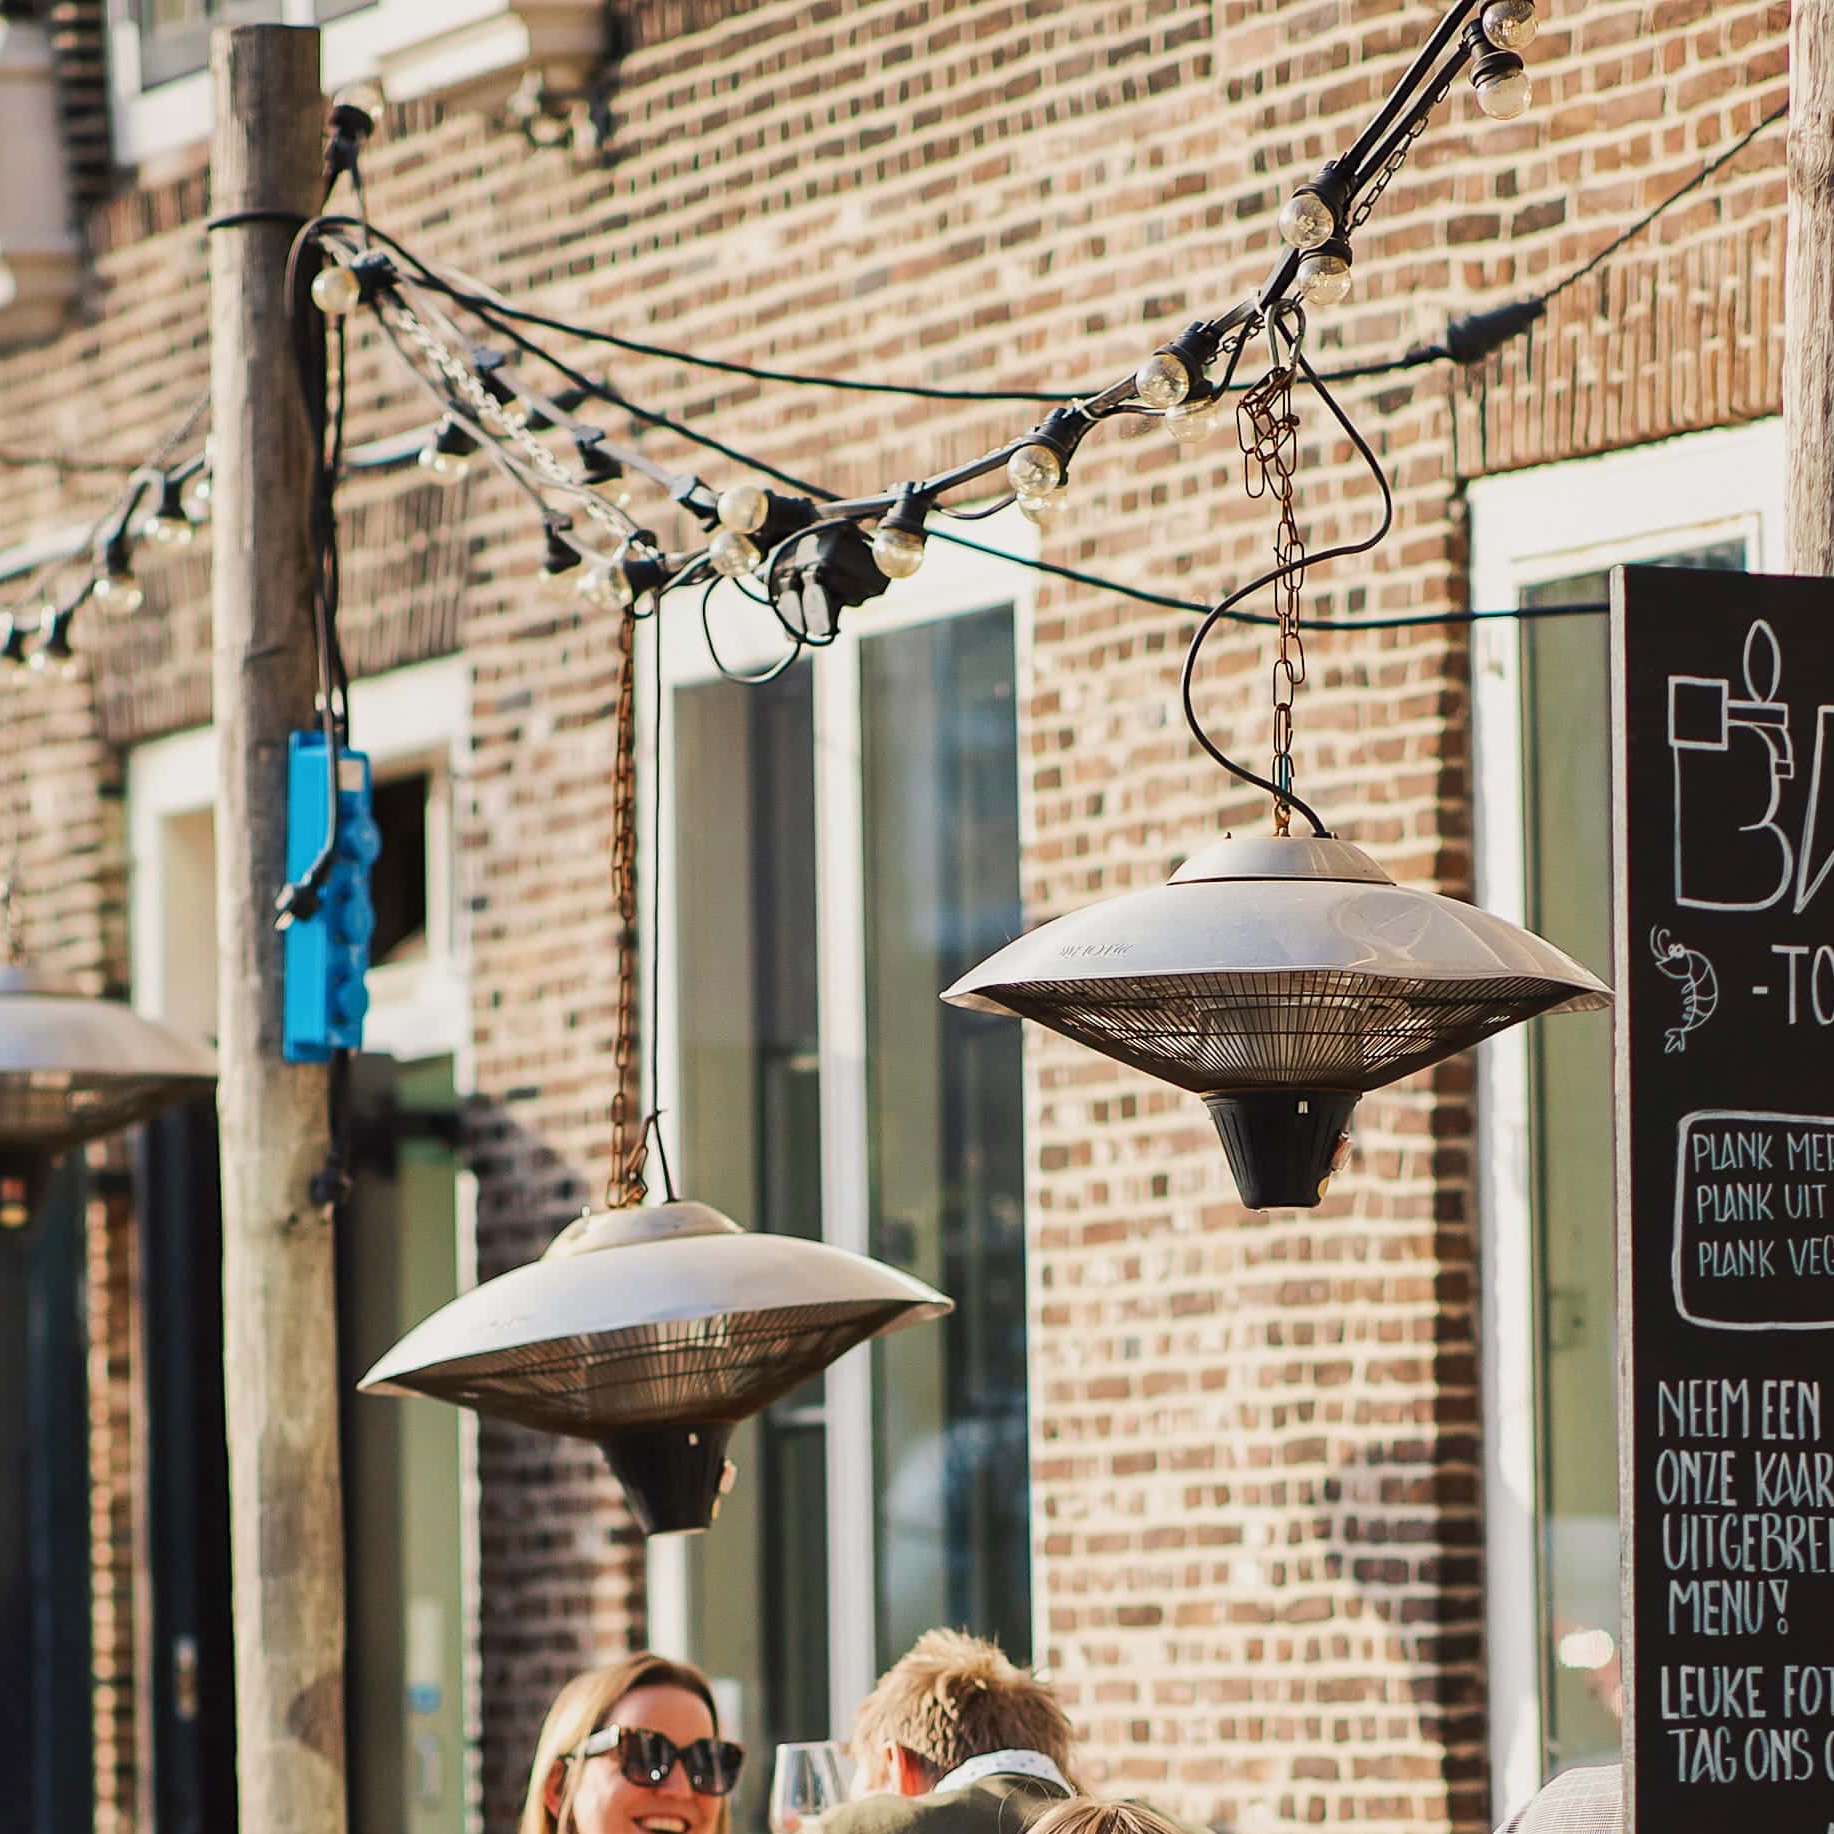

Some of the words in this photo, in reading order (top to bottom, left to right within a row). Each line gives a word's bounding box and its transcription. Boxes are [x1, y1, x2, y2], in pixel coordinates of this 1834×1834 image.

[1693, 1132, 1772, 1172] PLANK
[1697, 1183, 1774, 1224] PLANK
[1785, 1184, 1826, 1218] UIT
[1699, 1240, 1775, 1277] PLANK
[1659, 1379, 1749, 1438] NEEM
[1762, 1380, 1820, 1441] EEN
[1656, 1449, 1737, 1506] ONZE
[1669, 1580, 1788, 1635] MENU!
[1661, 1665, 1766, 1719] LEUKE
[1667, 1726, 1737, 1783] TAG
[1745, 1728, 1813, 1781] ONS
